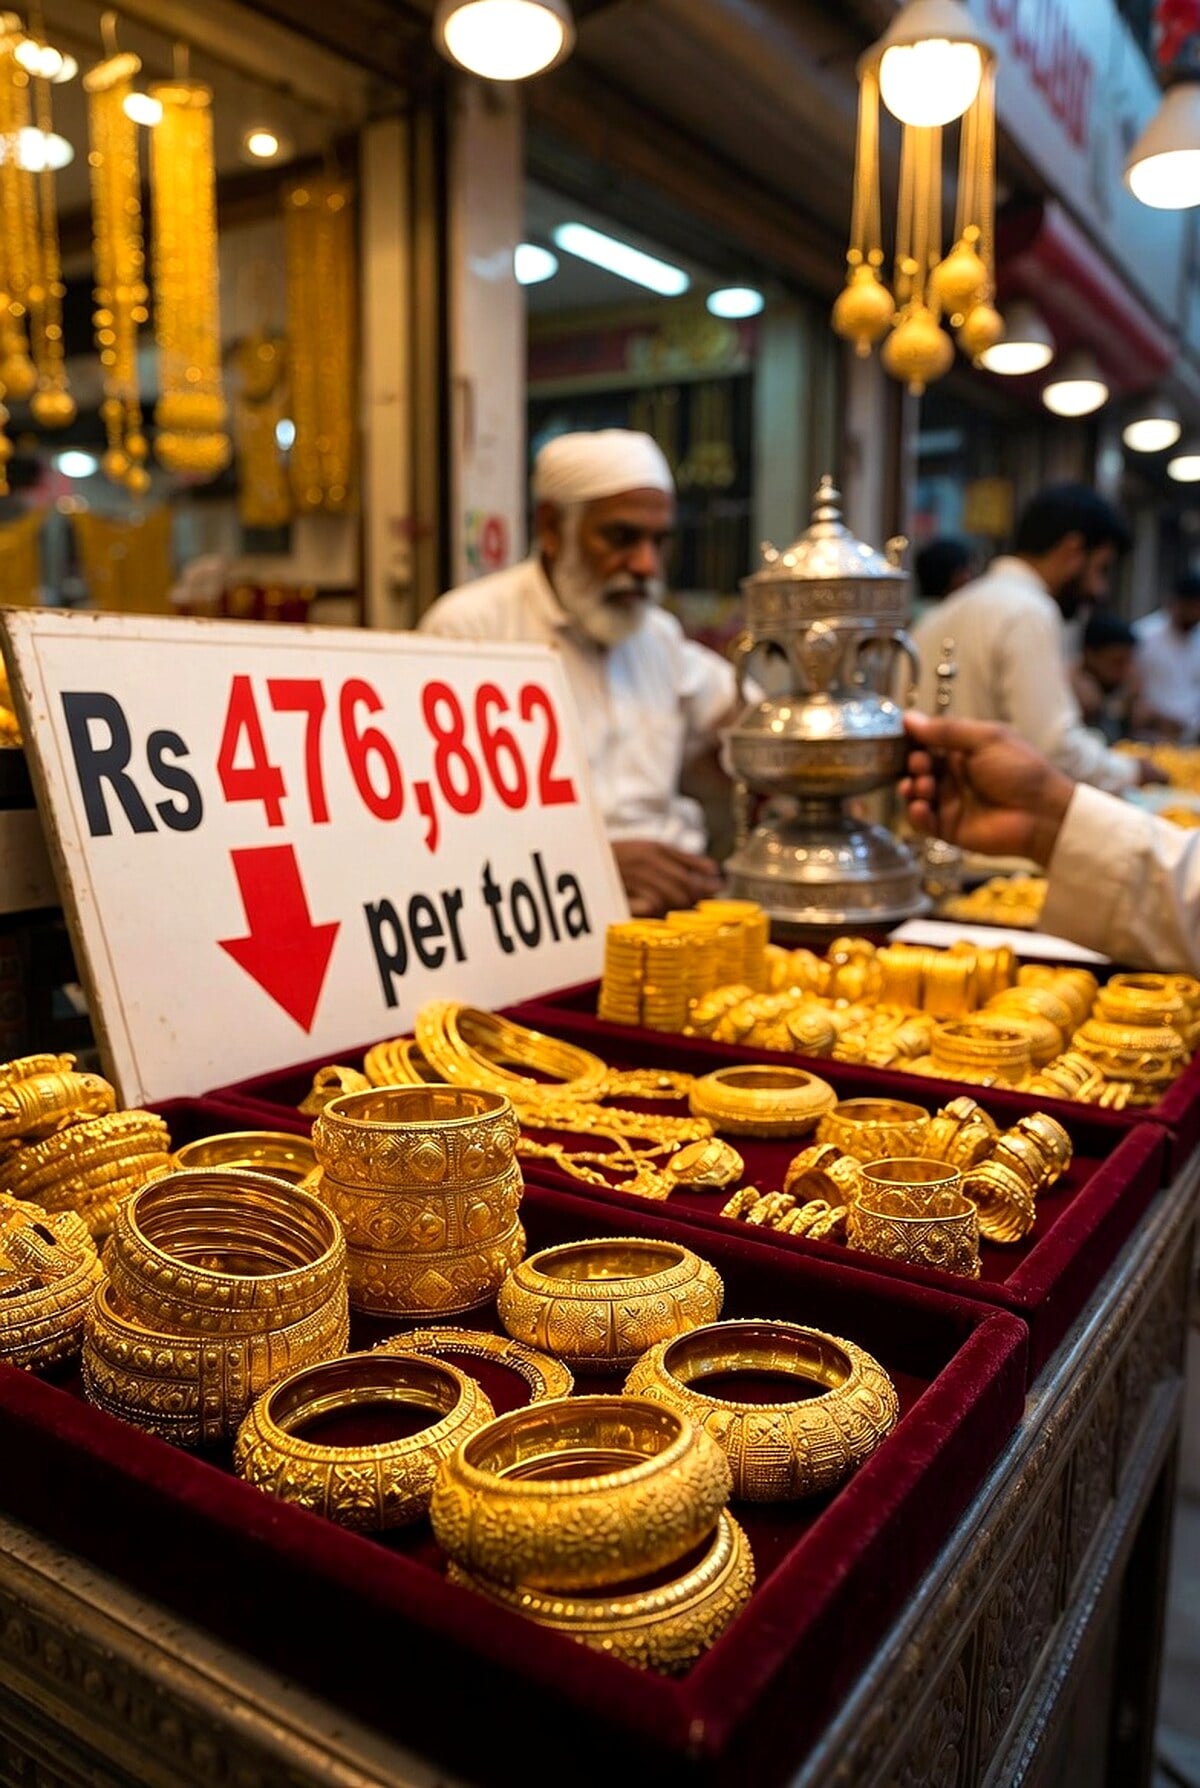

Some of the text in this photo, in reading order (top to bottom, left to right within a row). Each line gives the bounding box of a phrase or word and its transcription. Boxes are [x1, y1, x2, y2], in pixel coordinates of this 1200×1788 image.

[60, 675, 577, 854] Rs 476,862
[363, 852, 591, 1009] per tola
